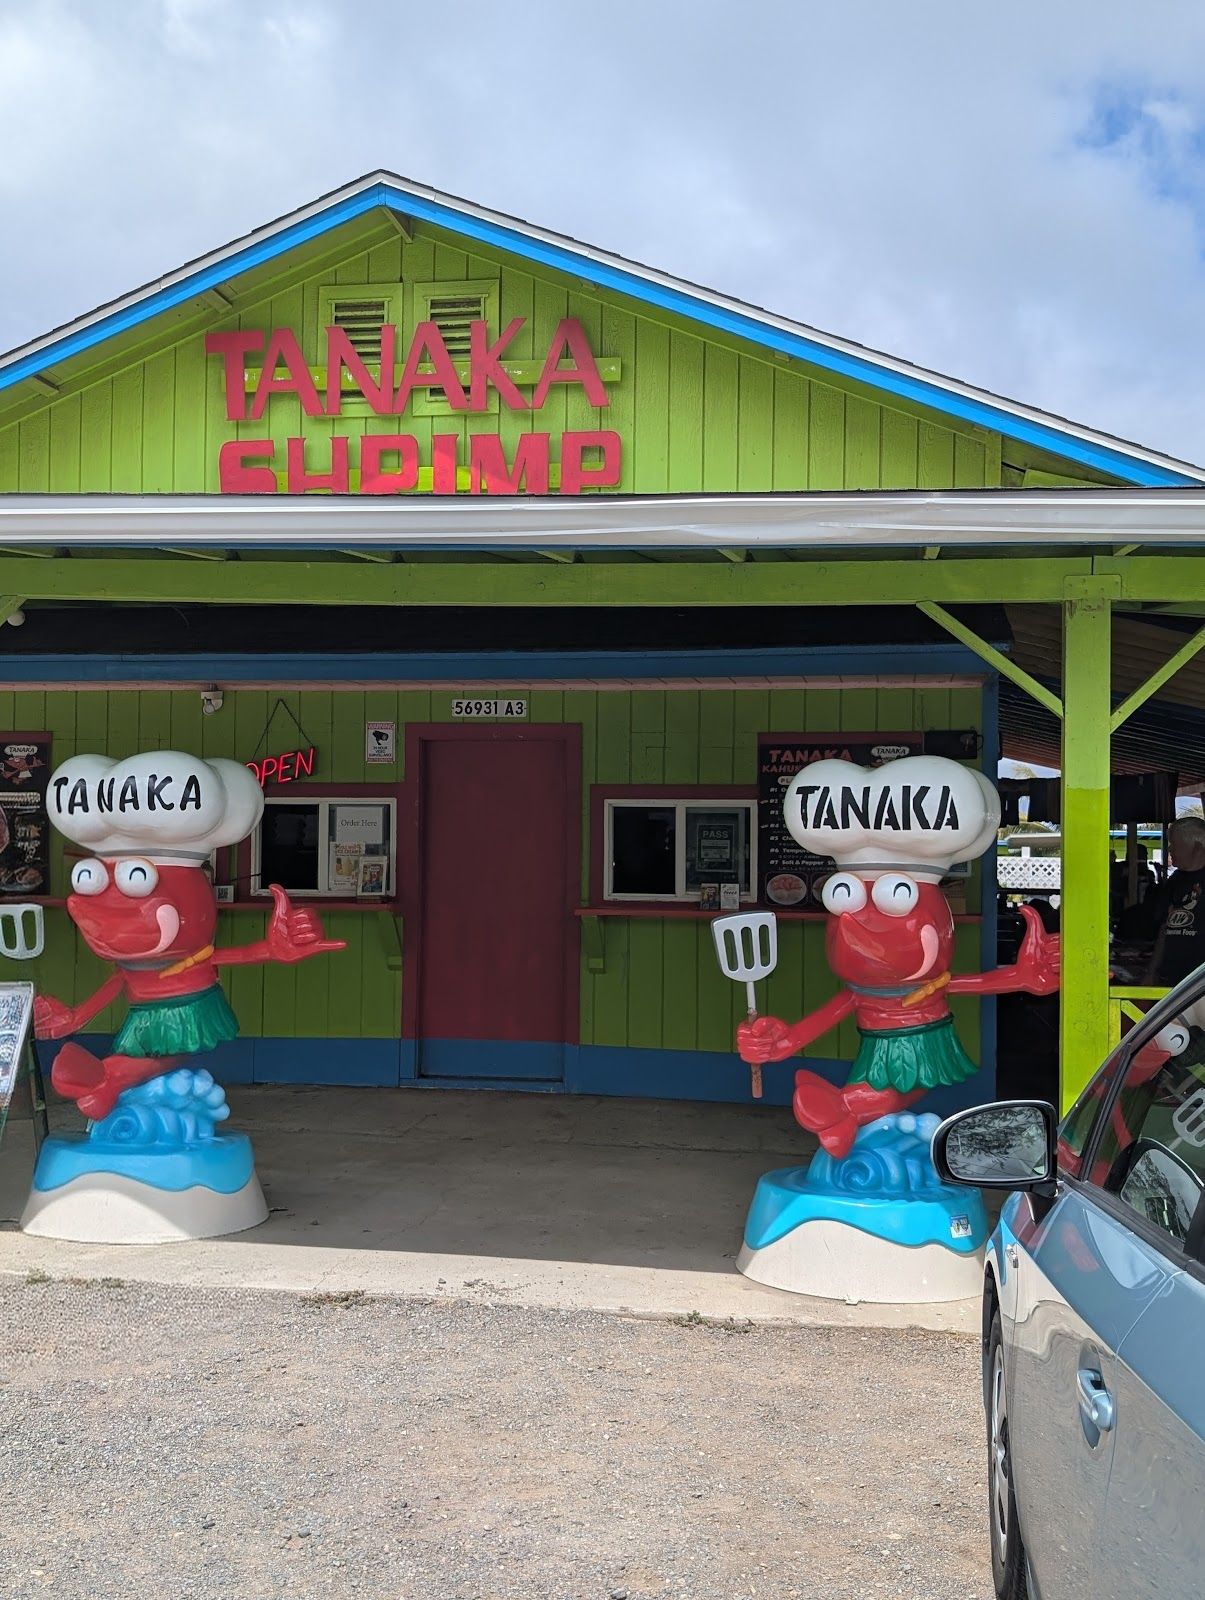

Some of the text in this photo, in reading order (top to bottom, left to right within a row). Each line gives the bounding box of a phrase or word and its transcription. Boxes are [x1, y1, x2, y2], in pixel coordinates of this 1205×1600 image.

[205, 317, 610, 420] TANAKA
[219, 430, 622, 495] SHRIMP
[455, 701, 524, 716] 56931 A3
[769, 749, 853, 763] TANAKA
[877, 747, 906, 755] TANAKA
[53, 773, 202, 815] TANAKA
[795, 785, 959, 830] TANAKA
[341, 819, 377, 827] Order Here
[703, 830, 728, 838] PASS
